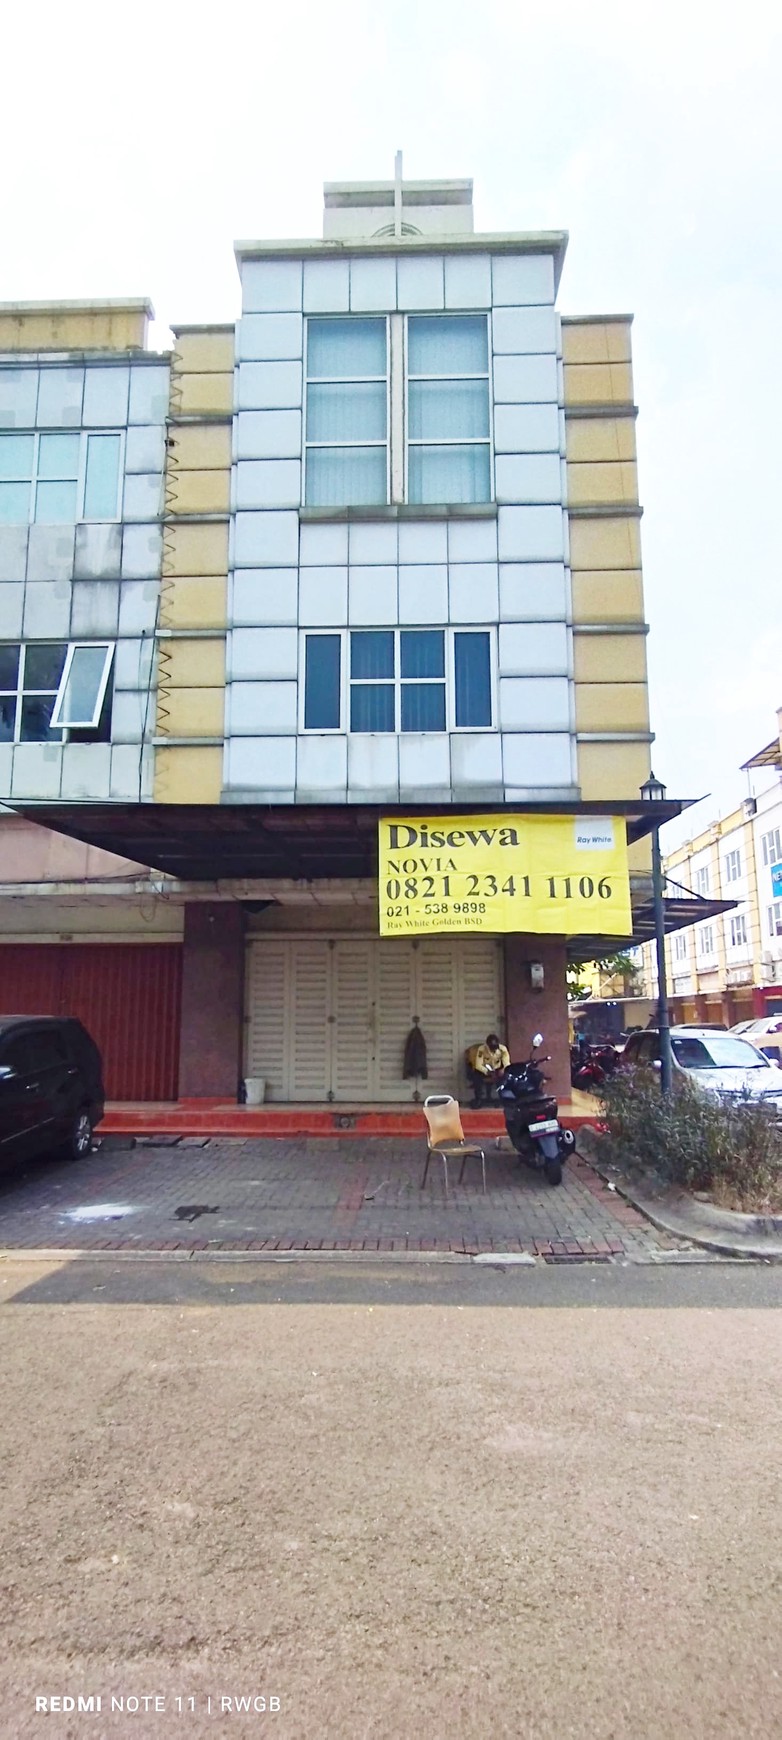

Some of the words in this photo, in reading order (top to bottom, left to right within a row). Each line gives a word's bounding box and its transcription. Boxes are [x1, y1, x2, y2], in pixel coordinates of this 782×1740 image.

[388, 824, 520, 849] Disewa
[577, 836, 591, 844] Ray
[387, 857, 458, 874] NOVIA
[386, 875, 452, 900] 0821
[466, 874, 533, 897] 2341
[547, 876, 612, 899] 1106
[386, 905, 410, 917] 021
[424, 903, 448, 914] 538
[453, 902, 486, 913] 9898
[387, 921, 403, 929] Ray
[406, 919, 430, 927] White
[432, 917, 462, 926] Golden
[464, 917, 483, 925] BSD
